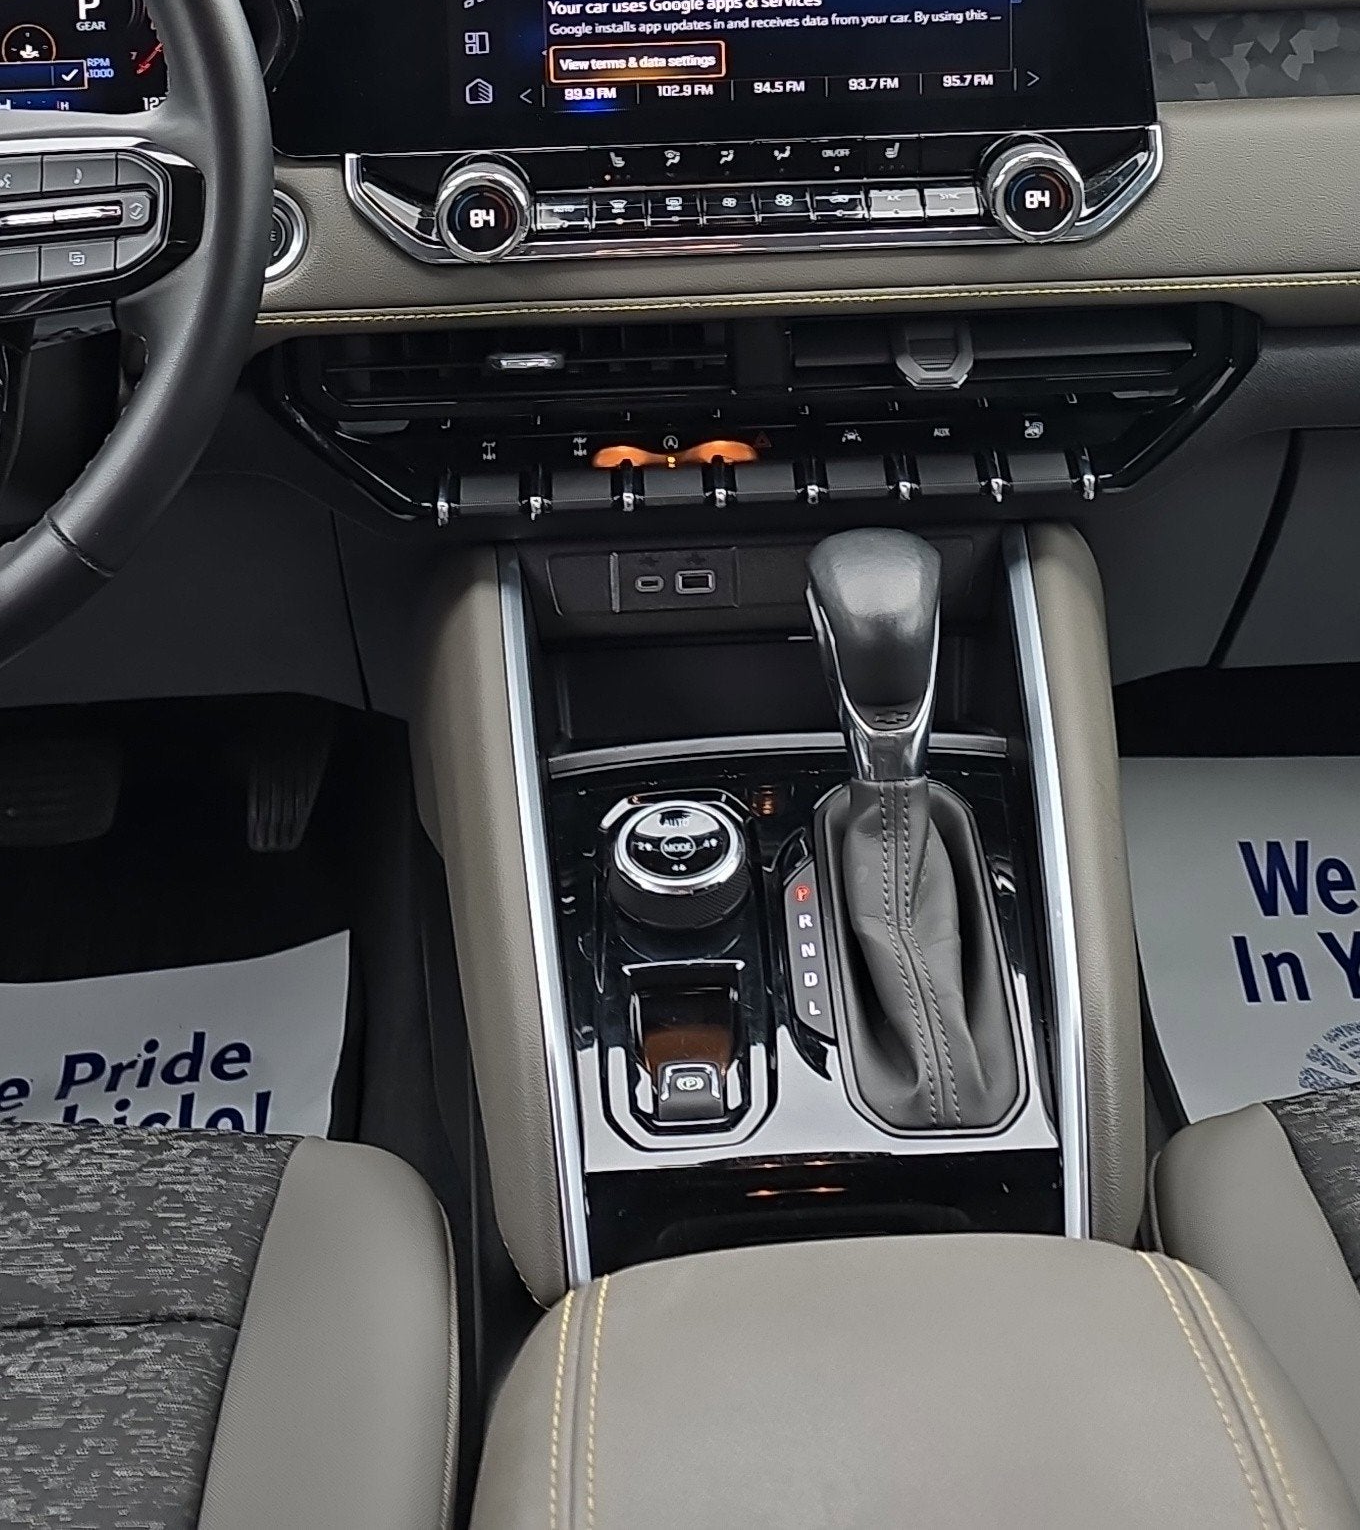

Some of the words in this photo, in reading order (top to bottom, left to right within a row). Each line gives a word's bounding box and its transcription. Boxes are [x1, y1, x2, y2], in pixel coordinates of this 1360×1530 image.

[548, 0, 582, 15] Your
[585, 1, 610, 14] car
[612, 0, 647, 13] uses
[76, 21, 106, 31] GEAR
[549, 22, 592, 37] Google
[595, 21, 636, 34] installs
[639, 23, 661, 34] app
[663, 19, 712, 33] updates
[713, 19, 725, 30] in
[726, 17, 750, 29] and
[751, 16, 800, 28] receives
[802, 15, 829, 27] data
[831, 13, 860, 26] from
[861, 15, 888, 27] your
[890, 13, 912, 24] car.
[914, 11, 929, 25] By
[931, 11, 963, 24] using
[965, 9, 988, 20] this
[86, 58, 110, 66] RPM
[559, 58, 589, 71] View
[591, 58, 626, 70] terms
[627, 57, 639, 69] &
[639, 56, 666, 67] data
[668, 54, 717, 68] settings
[753, 81, 783, 93] 94.5
[785, 80, 805, 92] FM
[848, 78, 877, 90] 93.7
[880, 77, 899, 89] FM
[942, 75, 973, 87] 95.7
[974, 74, 994, 86] FM
[564, 88, 595, 101] 99.9
[597, 87, 617, 99] FM
[657, 85, 692, 97] 102.9
[694, 84, 713, 96] FM
[142, 97, 167, 110] 12
[821, 148, 851, 158] ON/OFF
[1024, 189, 1050, 208] 84
[469, 209, 495, 228] 84
[933, 427, 950, 437] AUX
[663, 818, 690, 828] AUTO
[663, 842, 693, 853] MODE
[1239, 840, 1358, 917] We
[796, 886, 809, 901] P
[798, 914, 812, 928] R
[801, 942, 816, 958] N
[1233, 934, 1311, 1004] In
[803, 972, 817, 987] D
[808, 1001, 821, 1016] L
[53, 1031, 252, 1102] Pride
